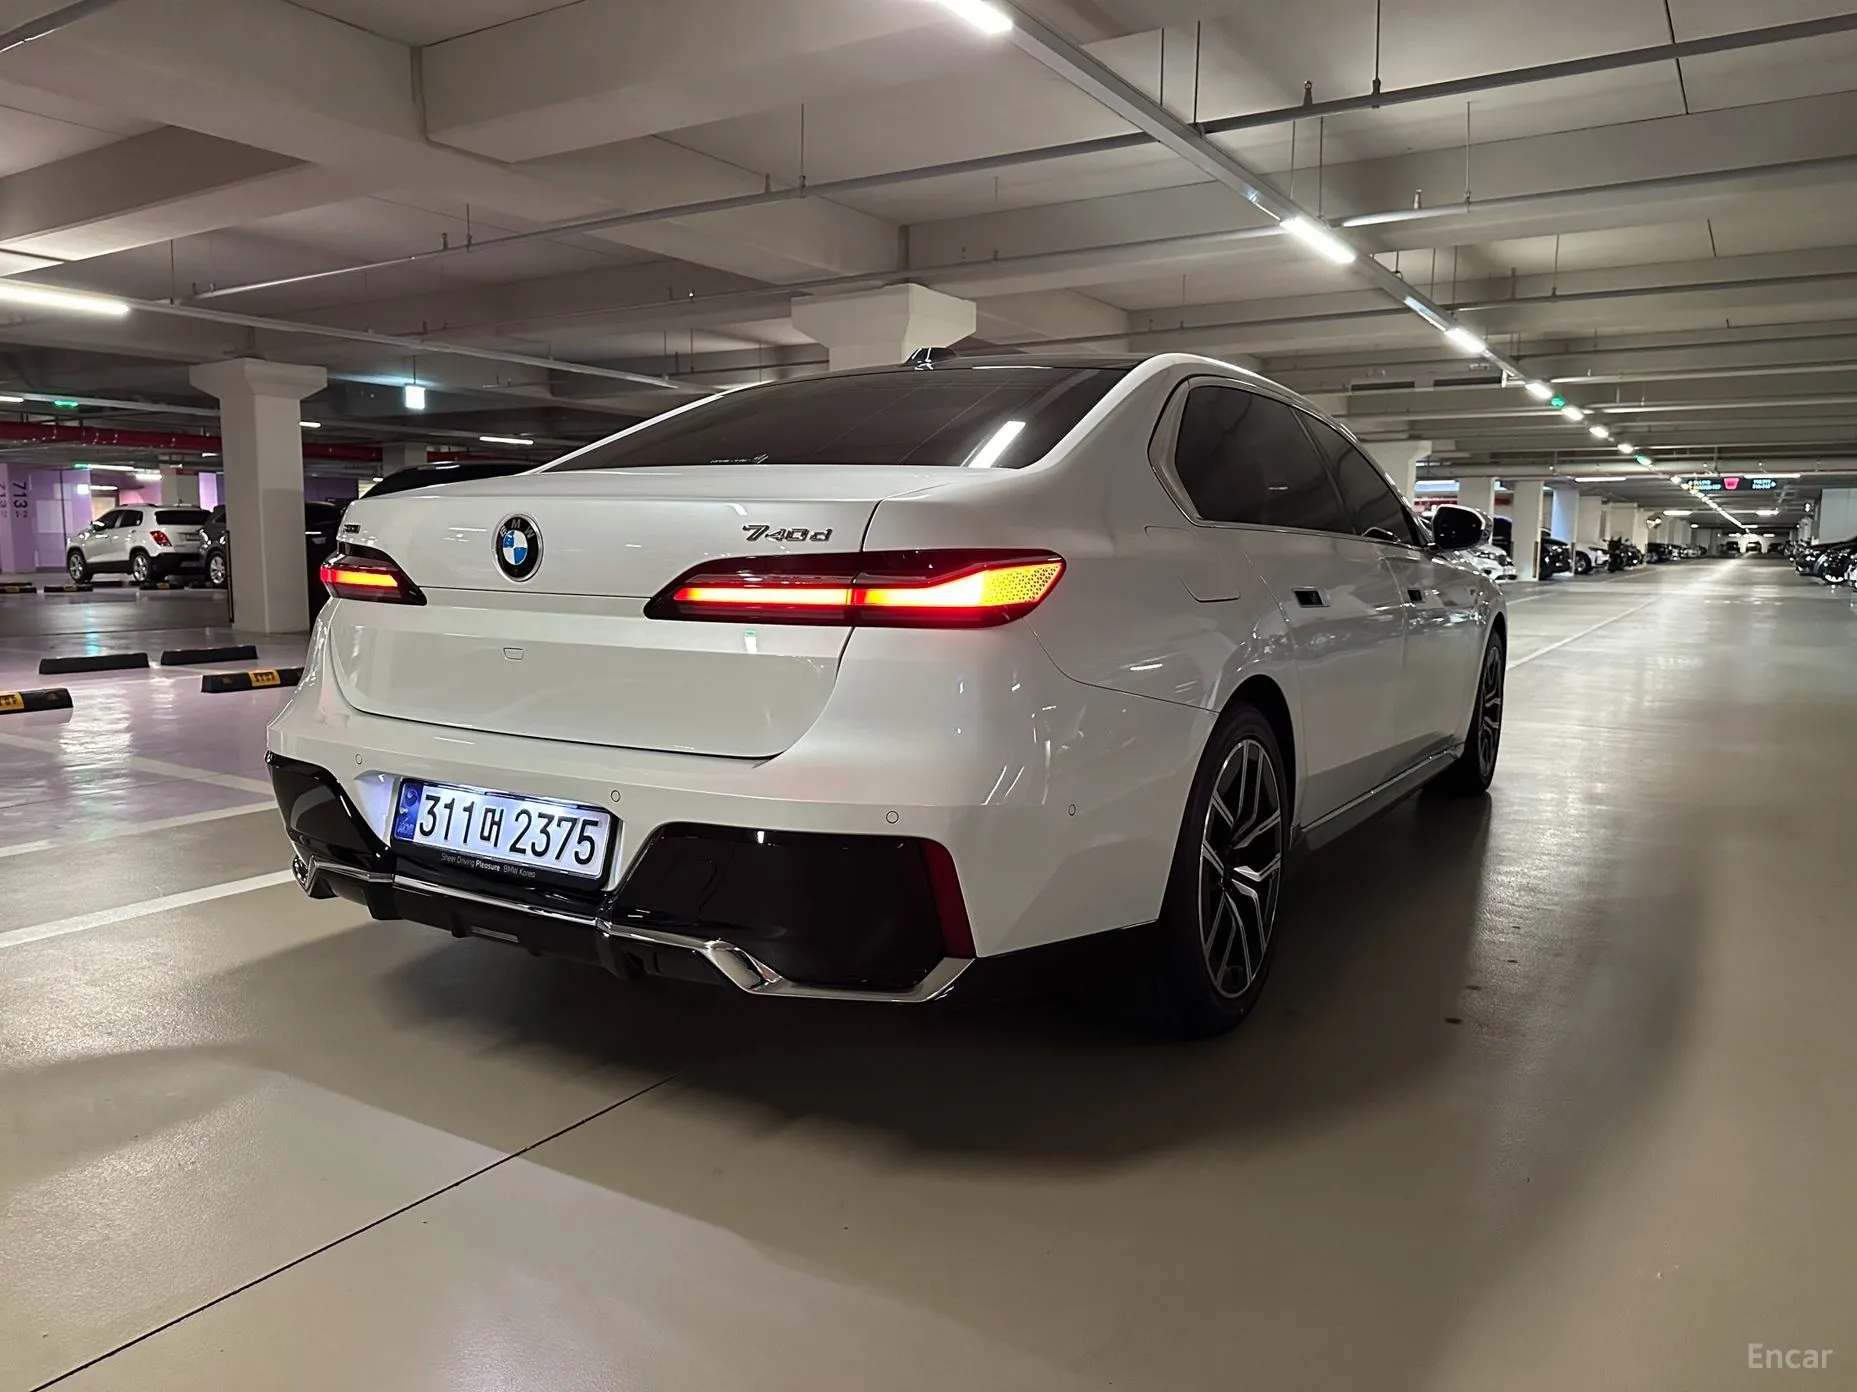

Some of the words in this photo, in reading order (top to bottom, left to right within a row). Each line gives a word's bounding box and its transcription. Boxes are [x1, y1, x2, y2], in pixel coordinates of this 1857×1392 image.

[12, 481, 28, 508] 713
[499, 519, 536, 538] BMW
[742, 524, 833, 541] 740d
[419, 794, 505, 848] 311머
[509, 808, 599, 865] 2375
[441, 852, 456, 862] Sheer
[457, 856, 475, 868] Driving
[475, 859, 501, 872] Pleasure
[503, 865, 519, 875] BMW
[519, 868, 536, 878] Korea
